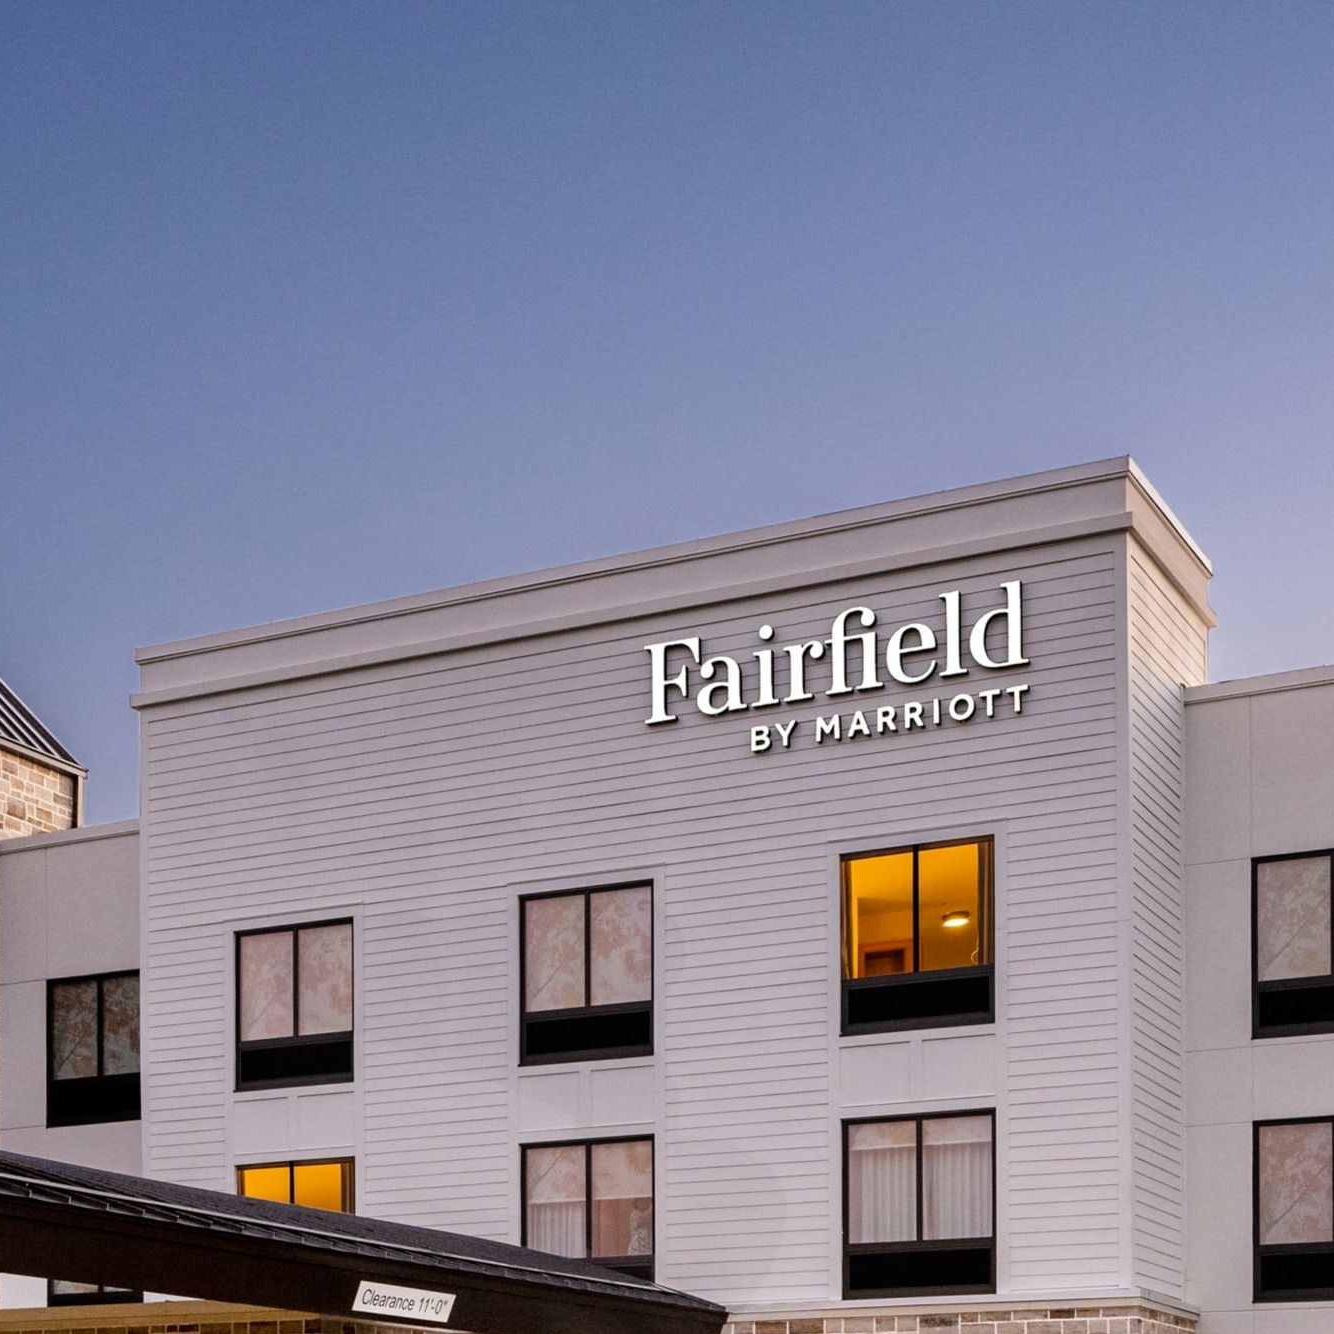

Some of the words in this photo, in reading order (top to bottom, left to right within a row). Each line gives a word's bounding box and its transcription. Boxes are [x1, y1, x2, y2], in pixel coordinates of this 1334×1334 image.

[643, 579, 1031, 726] Fairfield
[749, 718, 798, 754] BY
[814, 683, 1030, 744] MARRIOTT
[361, 1288, 415, 1312] Clearance
[418, 1297, 449, 1315] 11'-0"
